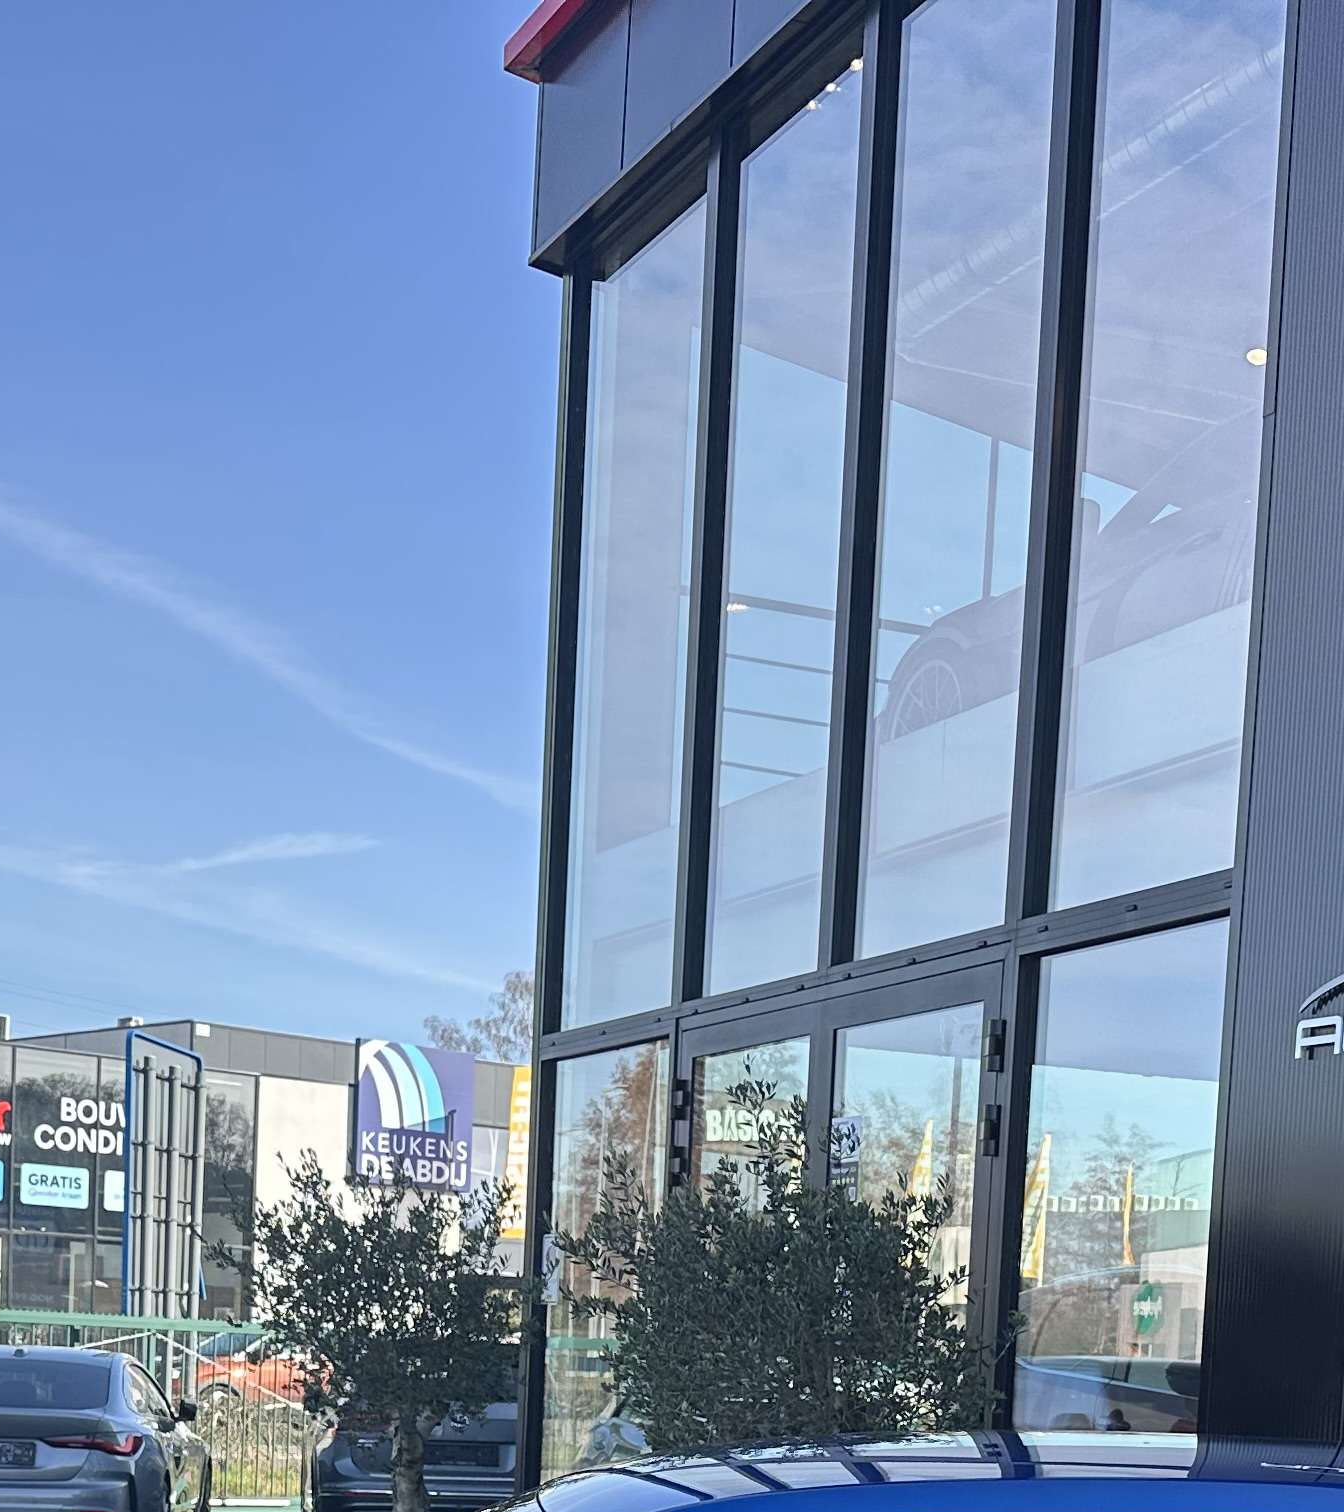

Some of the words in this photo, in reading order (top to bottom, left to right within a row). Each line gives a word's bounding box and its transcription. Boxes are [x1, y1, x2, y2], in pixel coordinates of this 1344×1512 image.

[361, 1130, 468, 1162] KEUKENS
[28, 1173, 82, 1190] GRATIS
[361, 1152, 394, 1180] DE
[402, 1157, 468, 1187] ABDIJ
